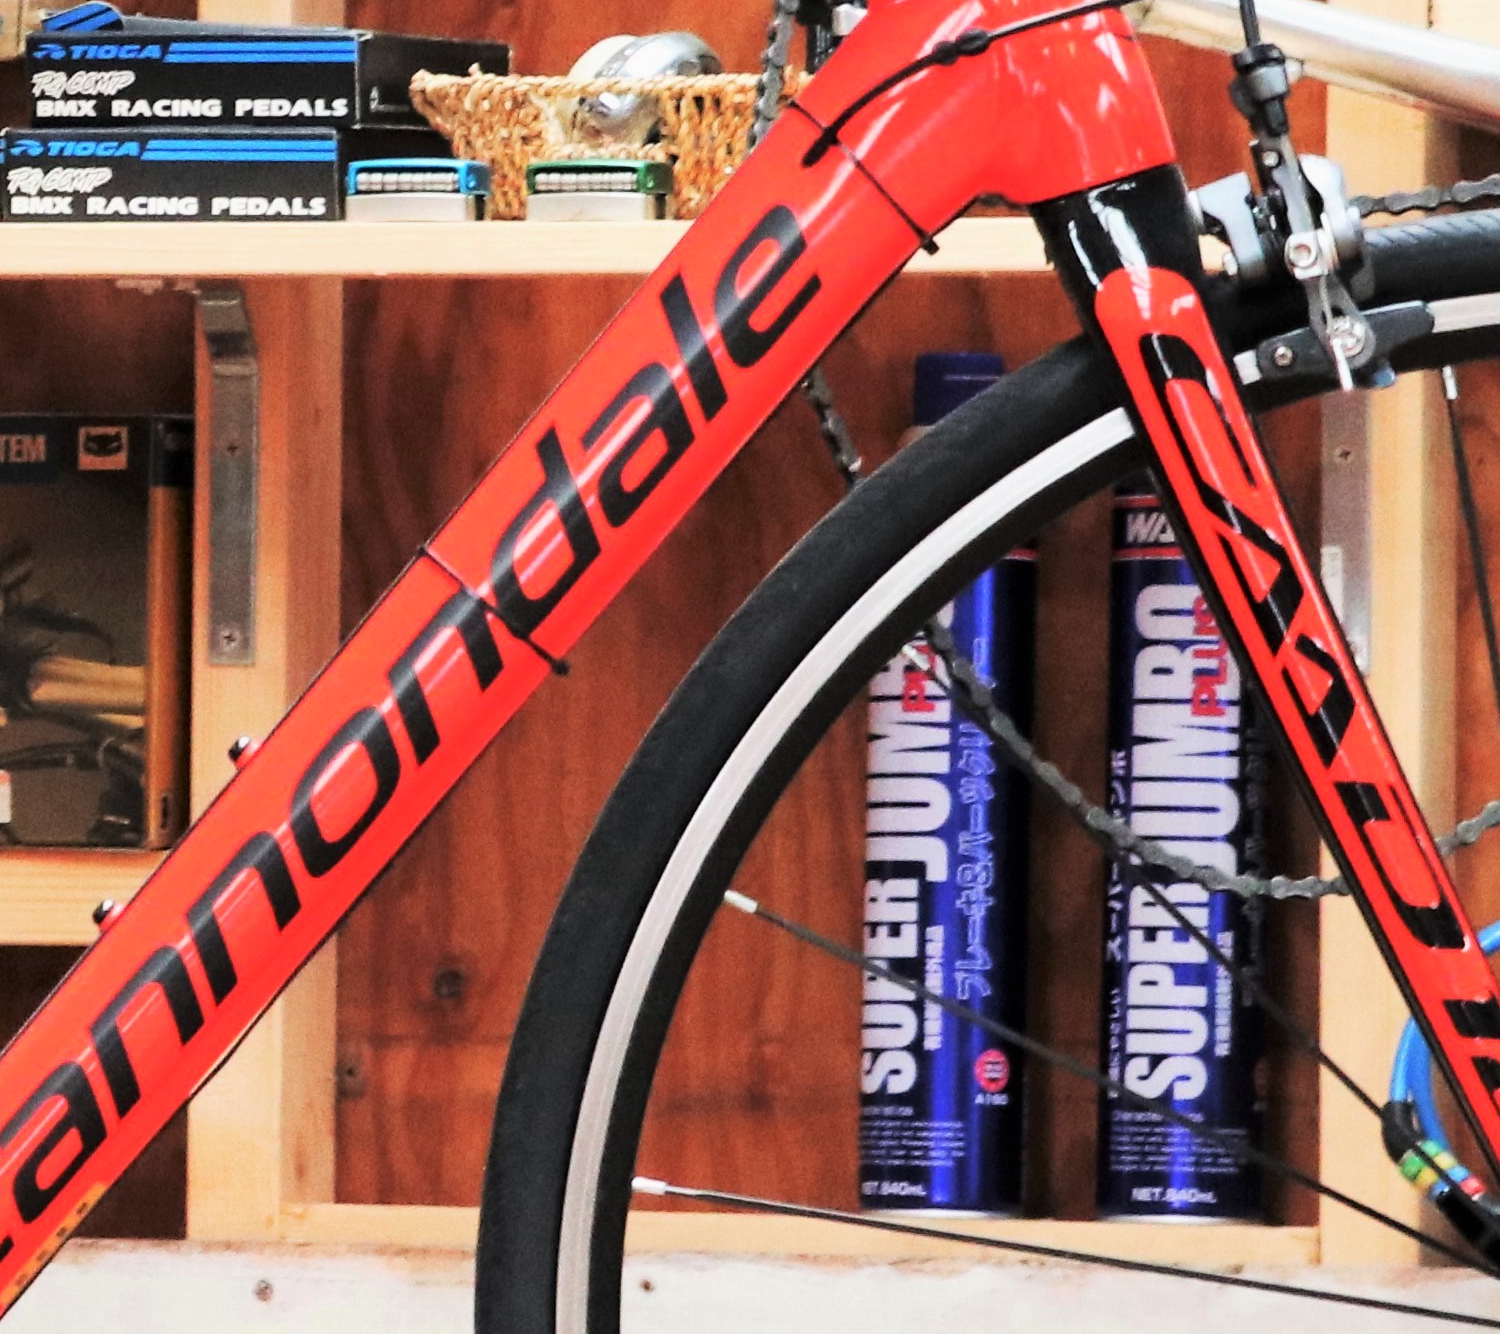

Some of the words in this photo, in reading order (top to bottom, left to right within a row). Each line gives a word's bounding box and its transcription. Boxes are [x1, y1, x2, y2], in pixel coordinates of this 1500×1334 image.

[36, 99, 96, 117] BMX
[111, 99, 222, 117] RACING
[234, 98, 349, 117] PEDALS
[70, 43, 162, 59] TIOGA
[11, 197, 73, 215] BMX
[87, 197, 198, 215] RACING
[211, 197, 326, 216] PEDALS
[47, 141, 141, 157] TIOGA
[1191, 593, 1229, 718] PLUS
[866, 598, 954, 882] JUM
[1133, 584, 1242, 875] JUMBO
[956, 637, 993, 1000] ブレーキ&パーツクリー
[860, 876, 920, 1095] SUPER
[1127, 878, 1211, 1100] SUPER
[862, 1183, 927, 1198] ET.840mL
